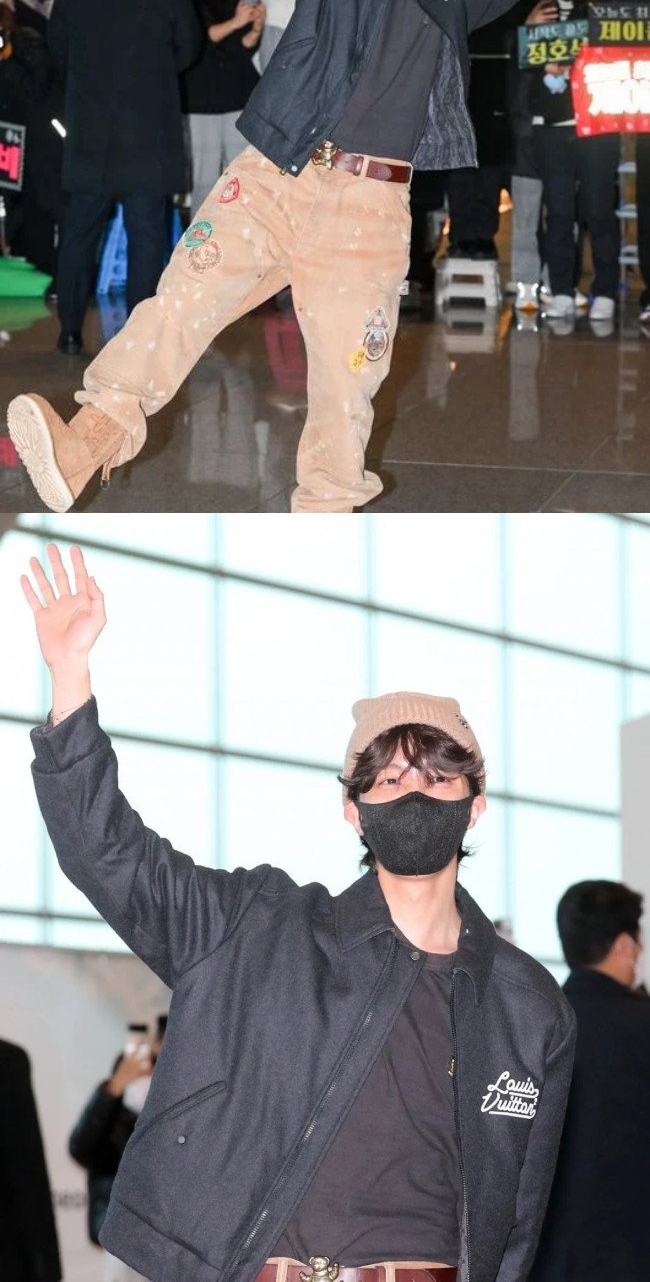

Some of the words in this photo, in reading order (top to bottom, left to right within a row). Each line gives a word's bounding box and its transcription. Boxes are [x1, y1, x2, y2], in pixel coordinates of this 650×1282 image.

[599, 20, 650, 41] 제이
[487, 1071, 539, 1098] Louis
[481, 1092, 537, 1119] Vuitton
